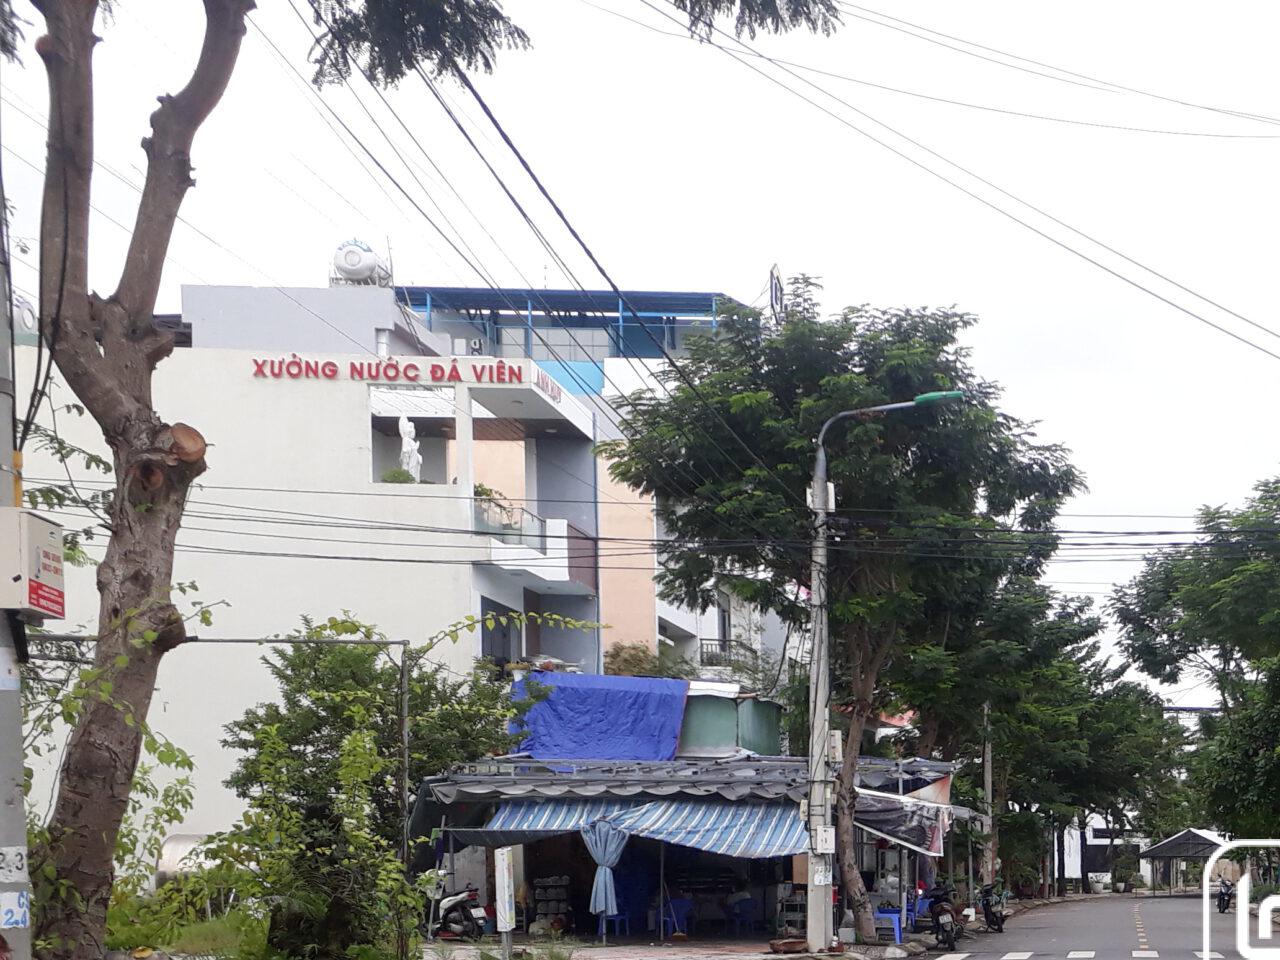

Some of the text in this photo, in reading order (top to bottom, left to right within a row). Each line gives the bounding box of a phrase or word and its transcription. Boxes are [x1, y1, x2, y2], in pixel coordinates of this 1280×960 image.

[252, 353, 523, 383] XƯỞNG NƯỚC ĐÁ VIÊN
